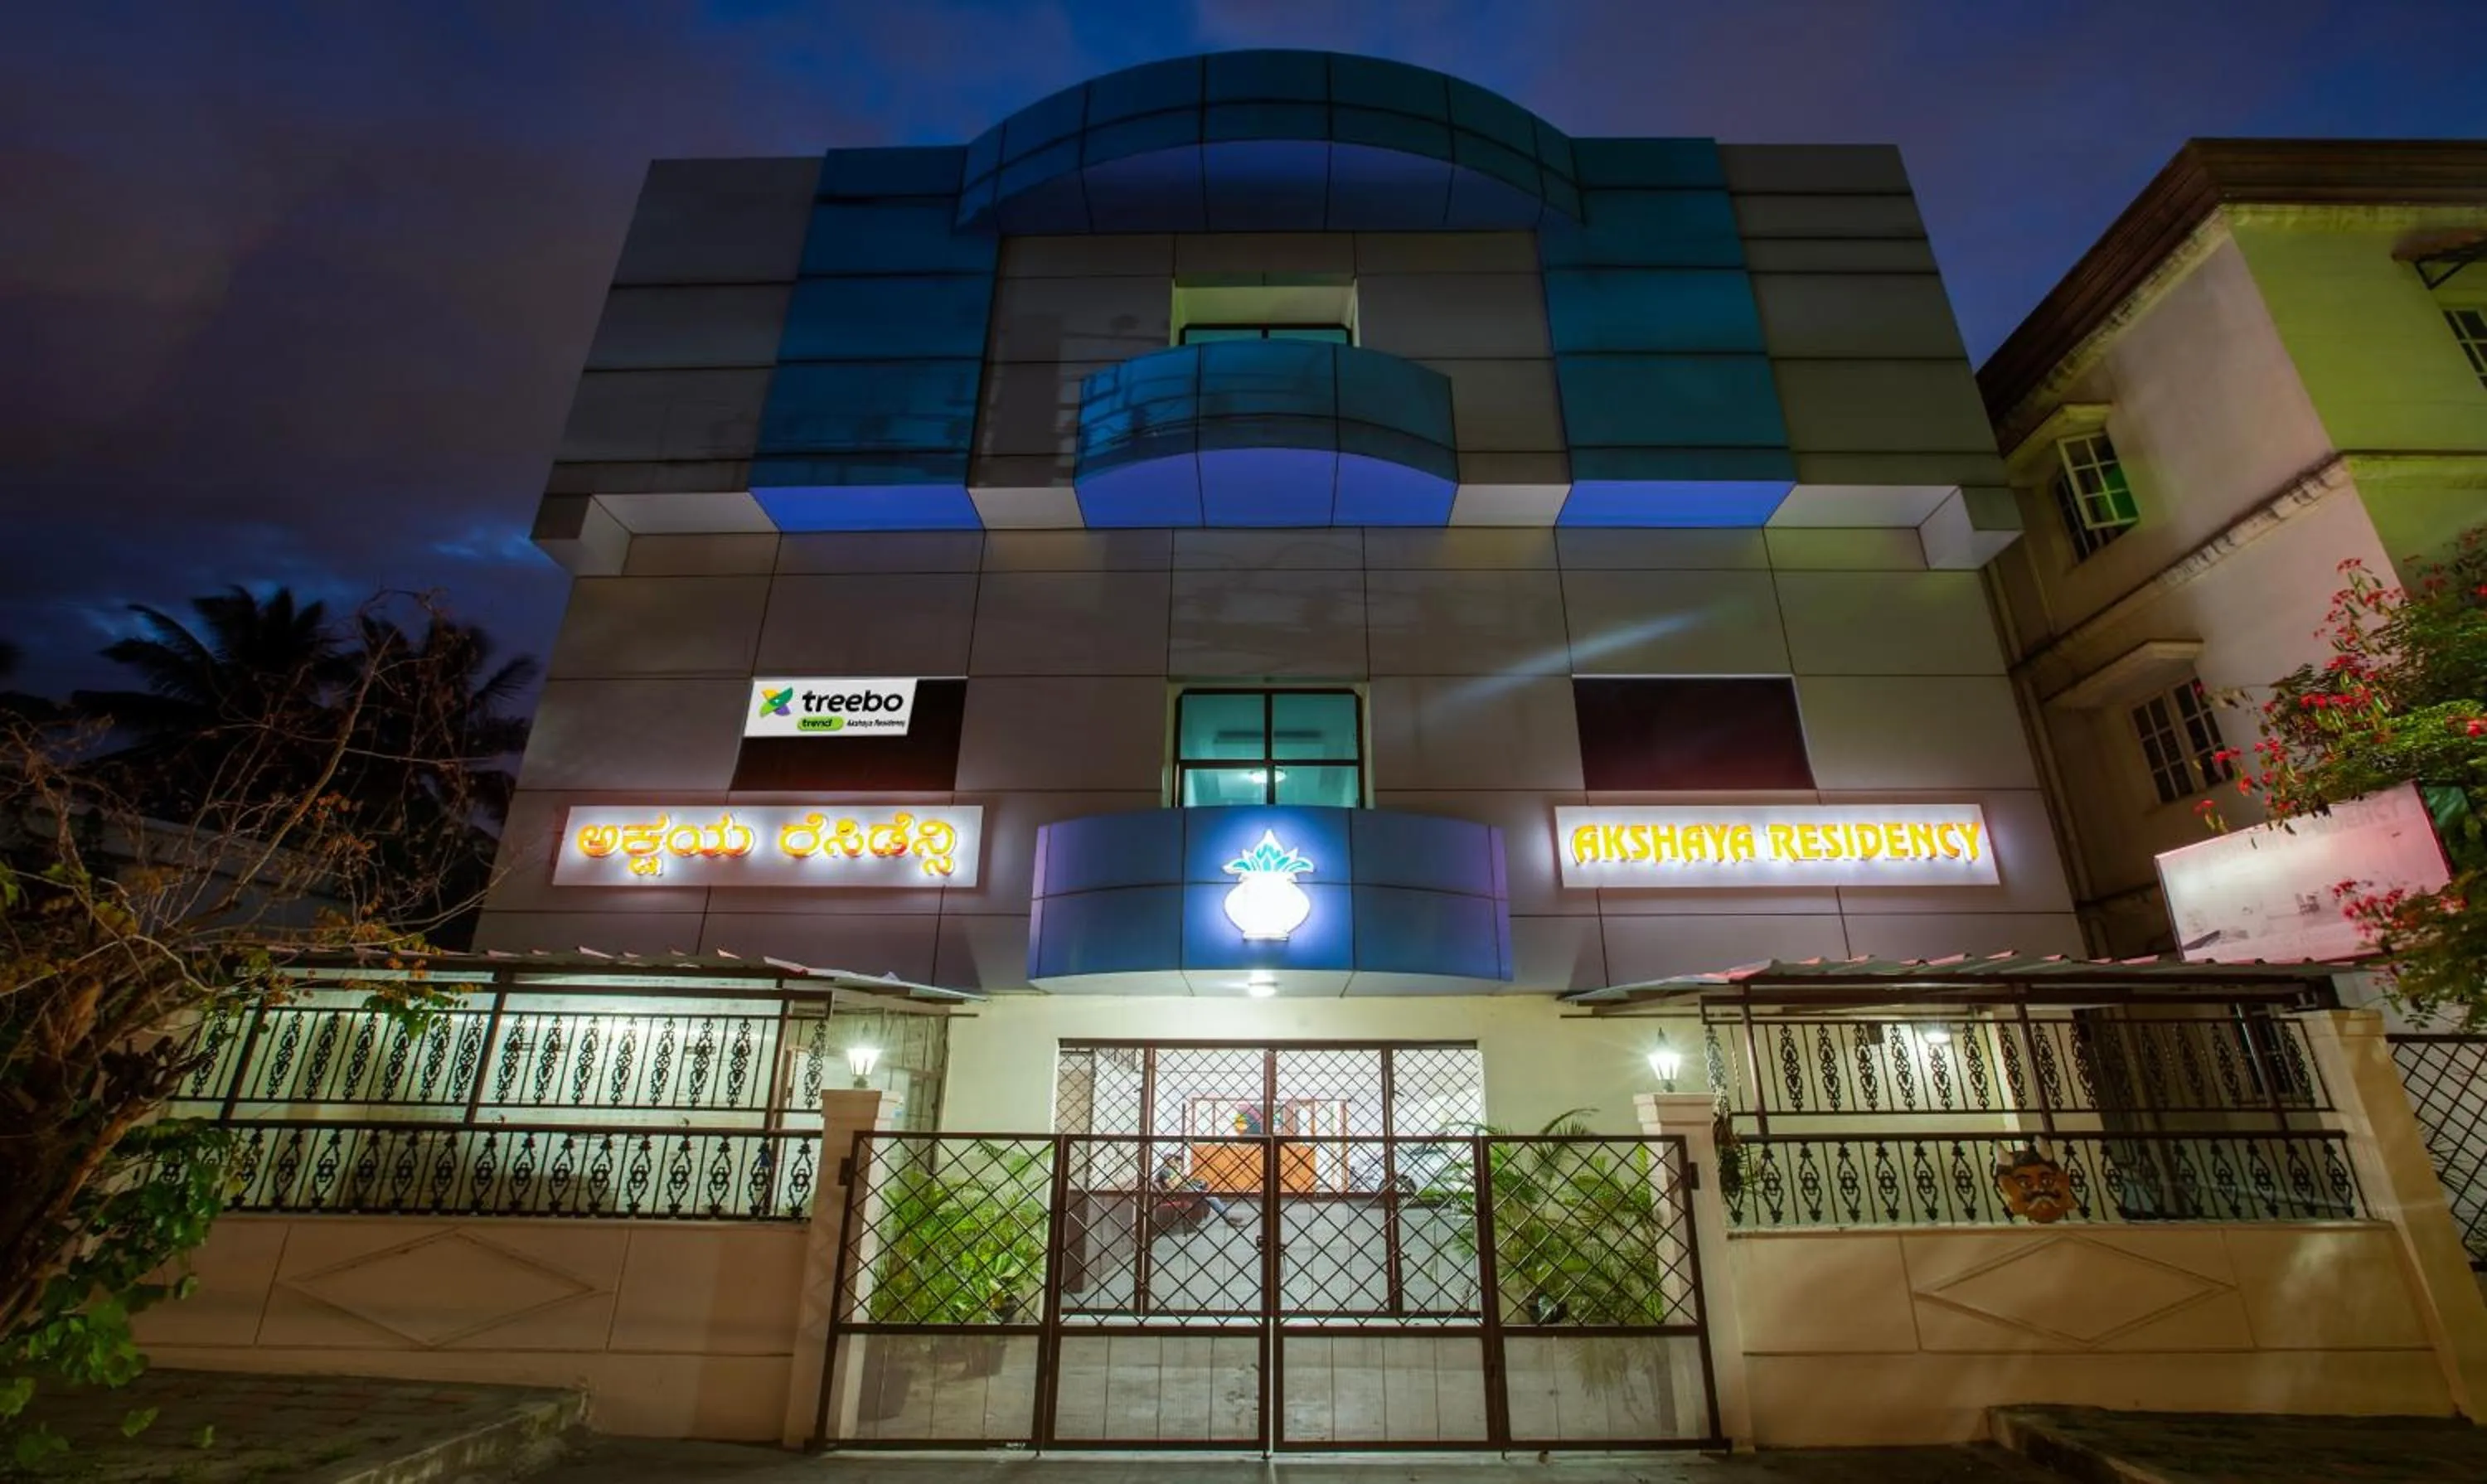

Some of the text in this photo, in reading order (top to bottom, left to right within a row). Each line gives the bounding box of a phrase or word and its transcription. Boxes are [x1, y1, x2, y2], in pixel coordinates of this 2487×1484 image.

[802, 690, 904, 712] treebo
[802, 718, 833, 728] trend
[1571, 822, 1981, 864] AKSHAYA RESIDENCY
